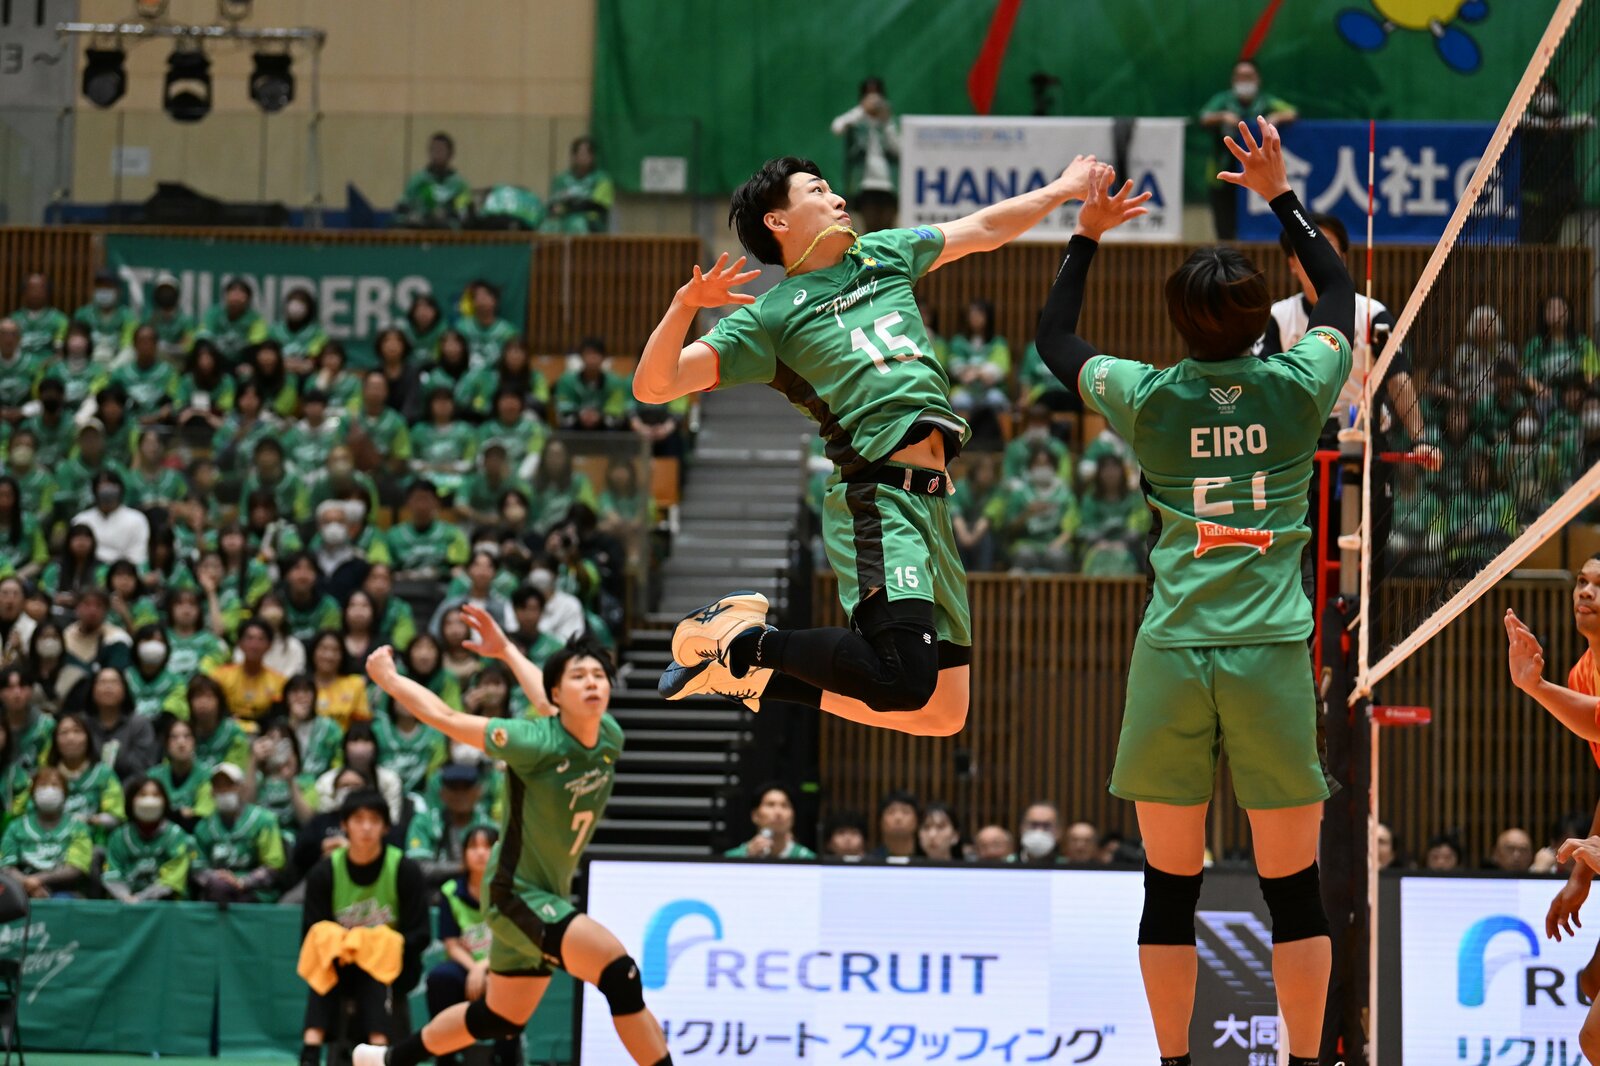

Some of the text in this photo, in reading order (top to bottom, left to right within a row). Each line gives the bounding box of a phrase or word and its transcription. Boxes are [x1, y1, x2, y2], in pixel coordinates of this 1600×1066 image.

[915, 167, 1166, 207] HANAA
[850, 311, 923, 375] 15
[1190, 423, 1268, 458] EIRO
[1193, 471, 1269, 518] 21
[894, 566, 920, 588] 15
[569, 811, 594, 856] 7
[706, 950, 999, 995] RECRUIT
[840, 1022, 1116, 1062] スタッフィング
